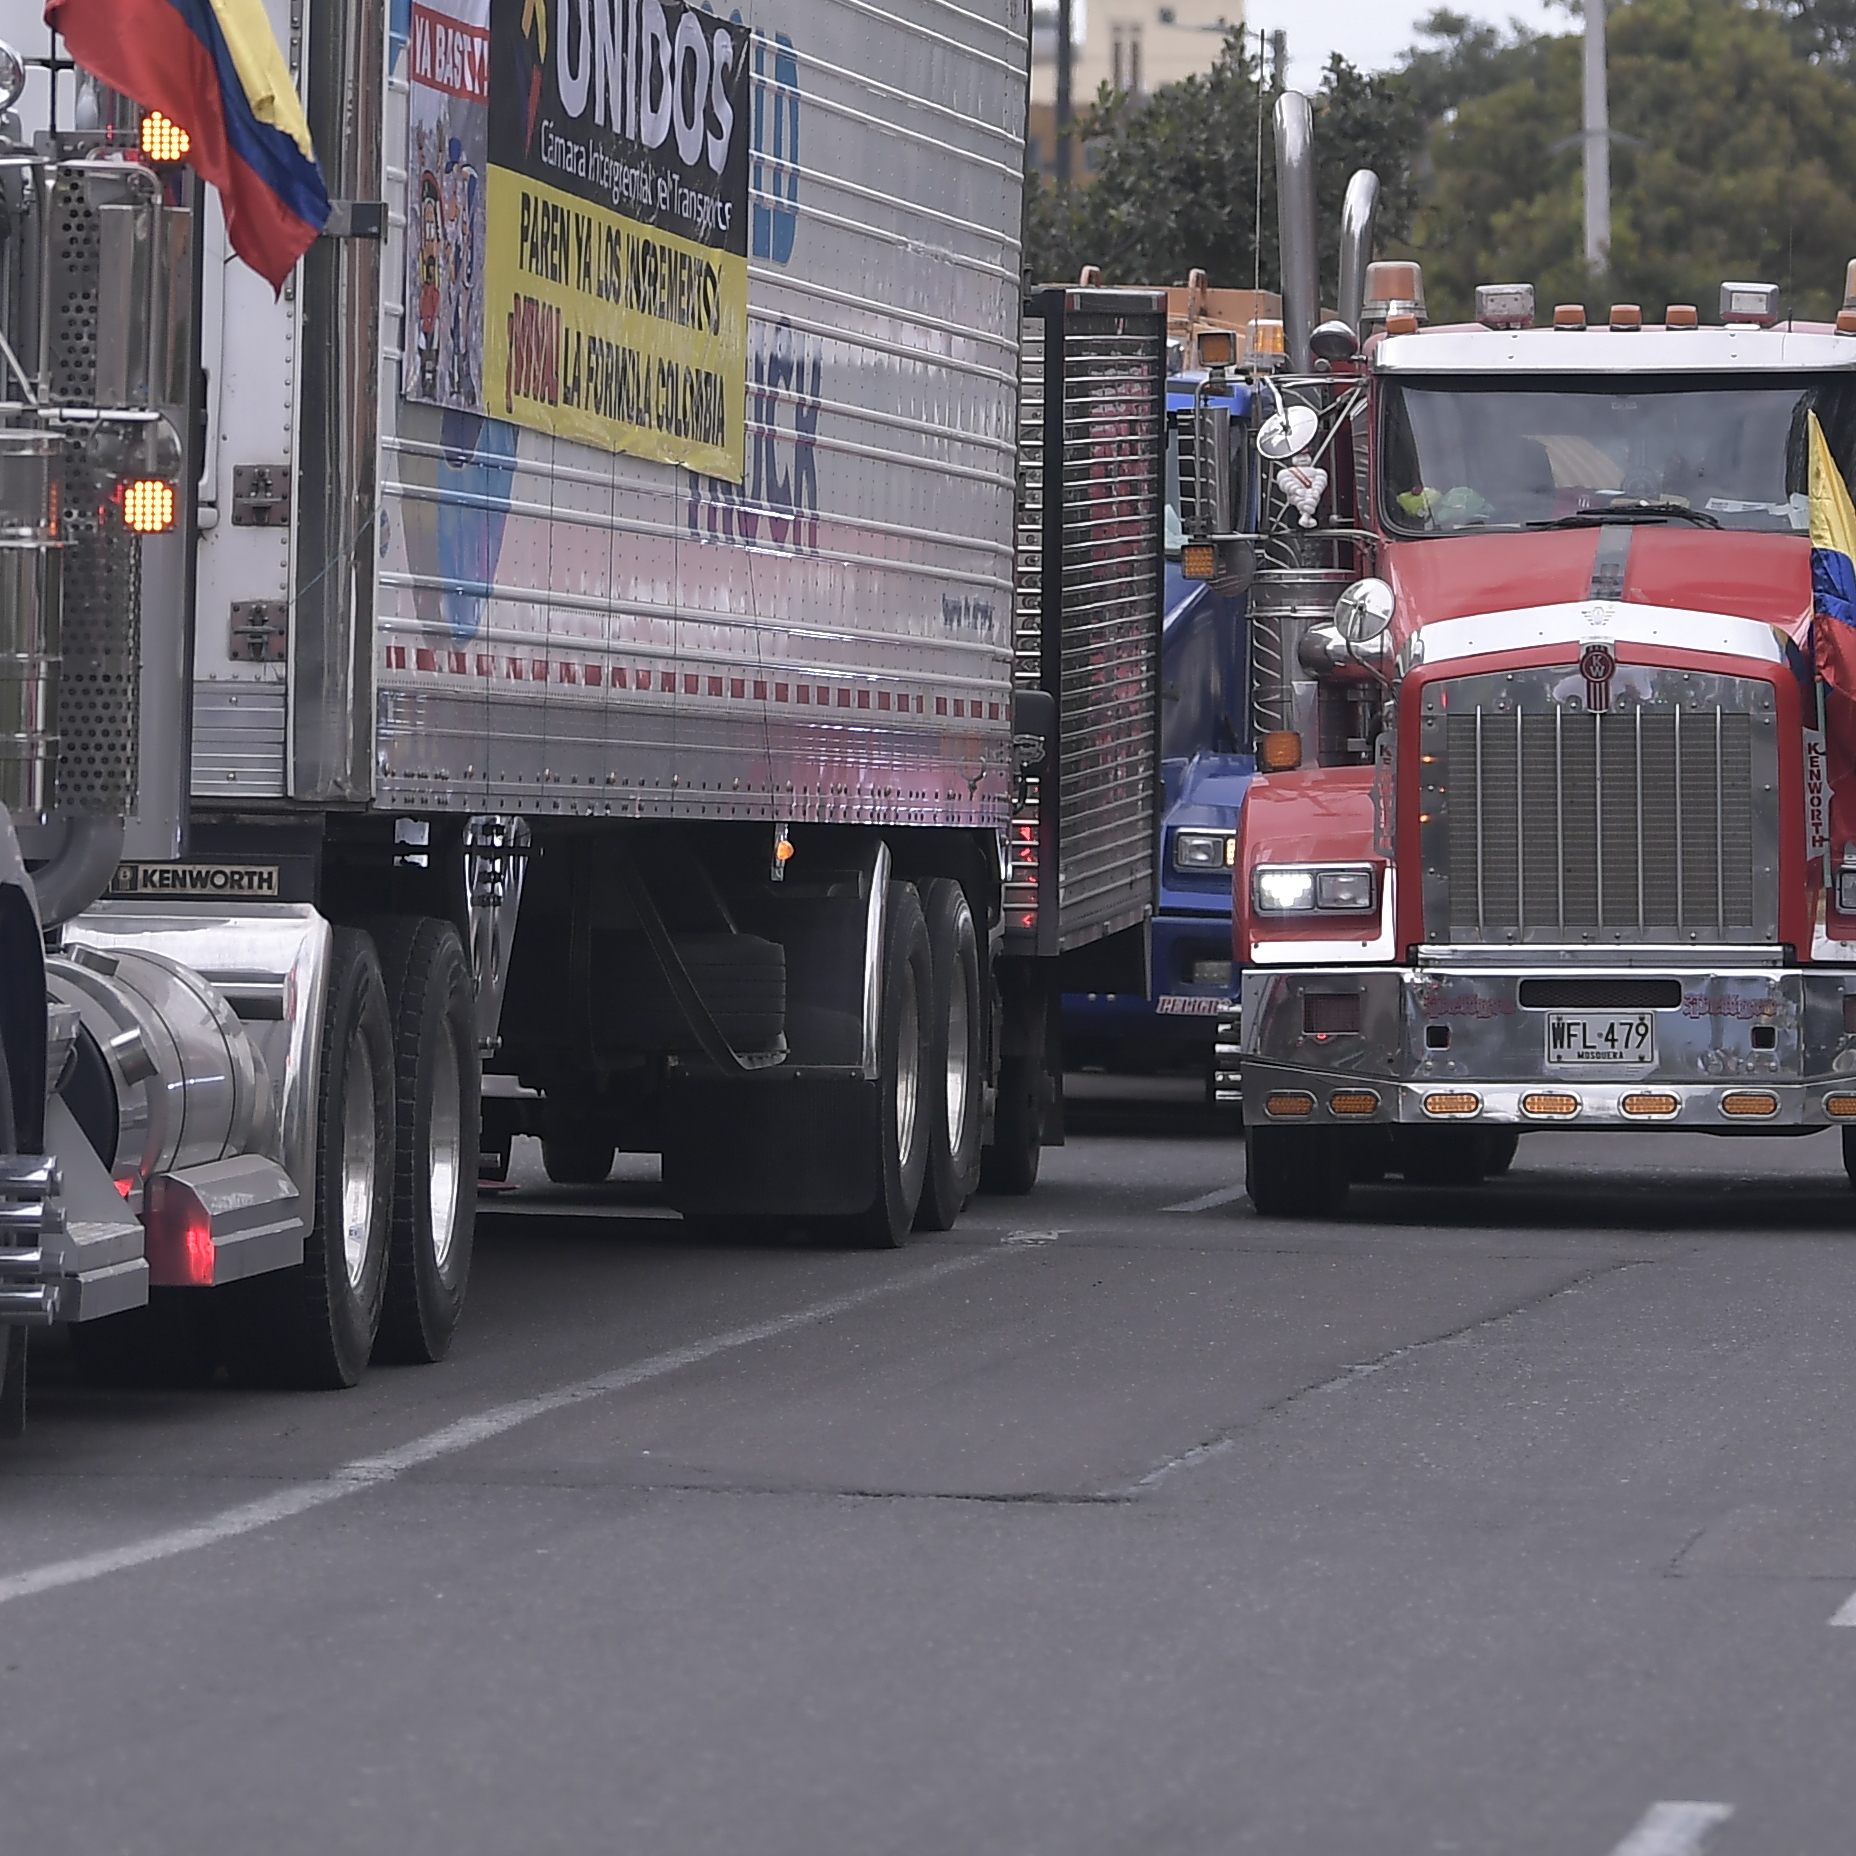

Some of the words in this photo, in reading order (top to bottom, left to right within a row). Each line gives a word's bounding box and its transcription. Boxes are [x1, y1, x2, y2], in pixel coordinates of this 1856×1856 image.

[415, 15, 432, 80] YA
[519, 192, 570, 286] PAREN
[574, 213, 593, 295] YA
[597, 221, 622, 305] LOS
[562, 327, 582, 409] LA
[1807, 742, 1825, 848] KENWORTH
[143, 869, 274, 891] KENWORTH
